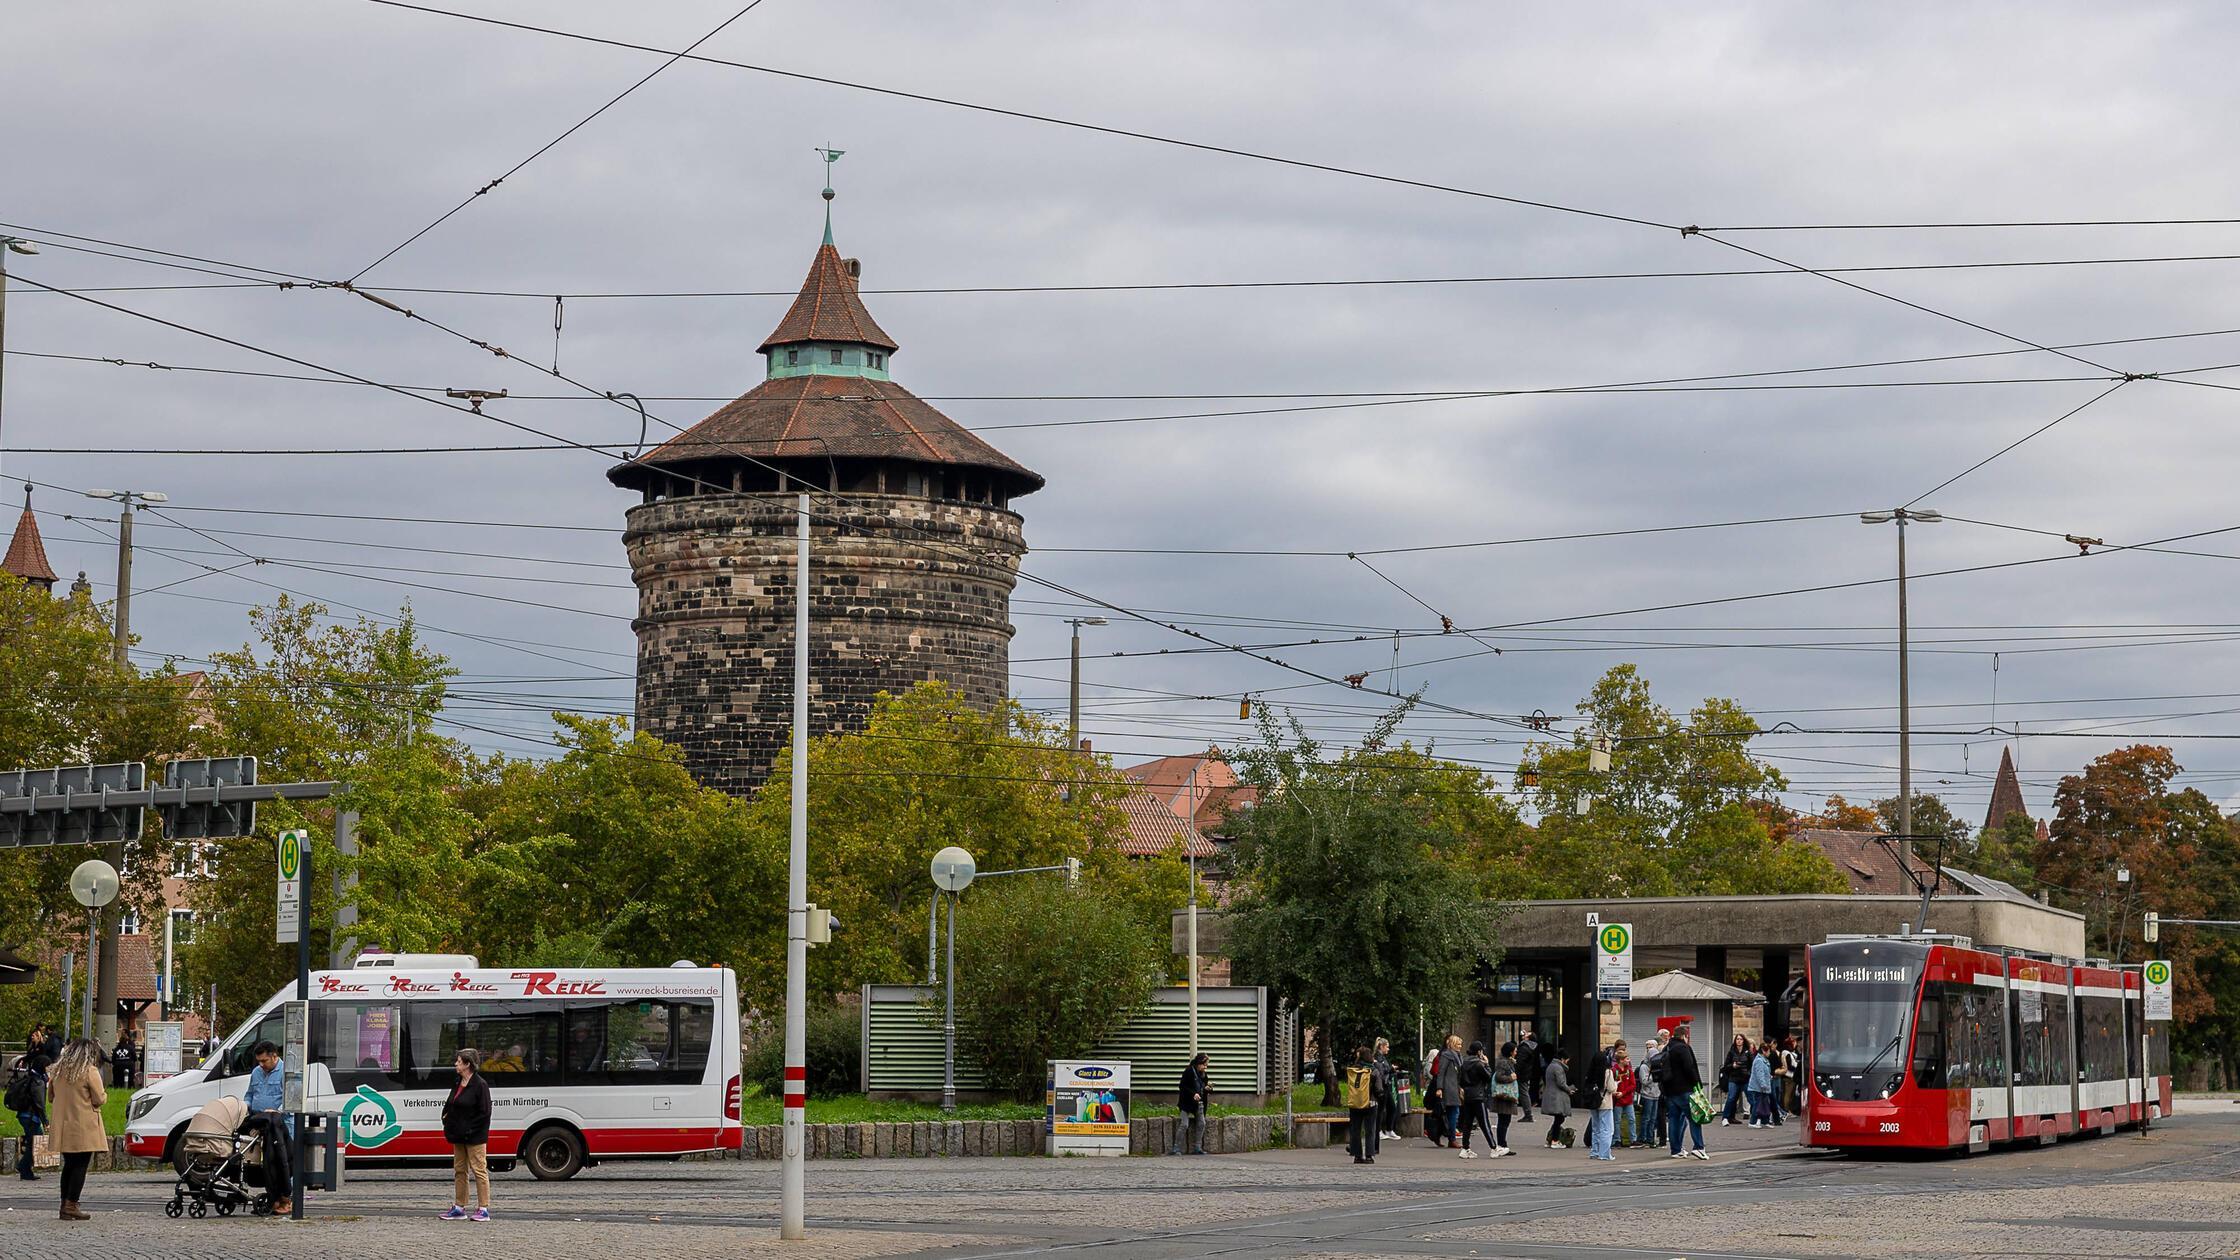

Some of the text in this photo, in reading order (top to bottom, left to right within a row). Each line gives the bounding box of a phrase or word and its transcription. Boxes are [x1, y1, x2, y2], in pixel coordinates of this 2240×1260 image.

[1524, 775, 1537, 785] 185
[1588, 915, 1597, 925] A
[616, 986, 719, 996] www.reck-busreisen.de
[513, 1097, 549, 1108] Nürnberg
[352, 1114, 385, 1126] VGN
[1815, 1121, 1831, 1132] 2003
[1880, 1122, 1900, 1133] 2003
